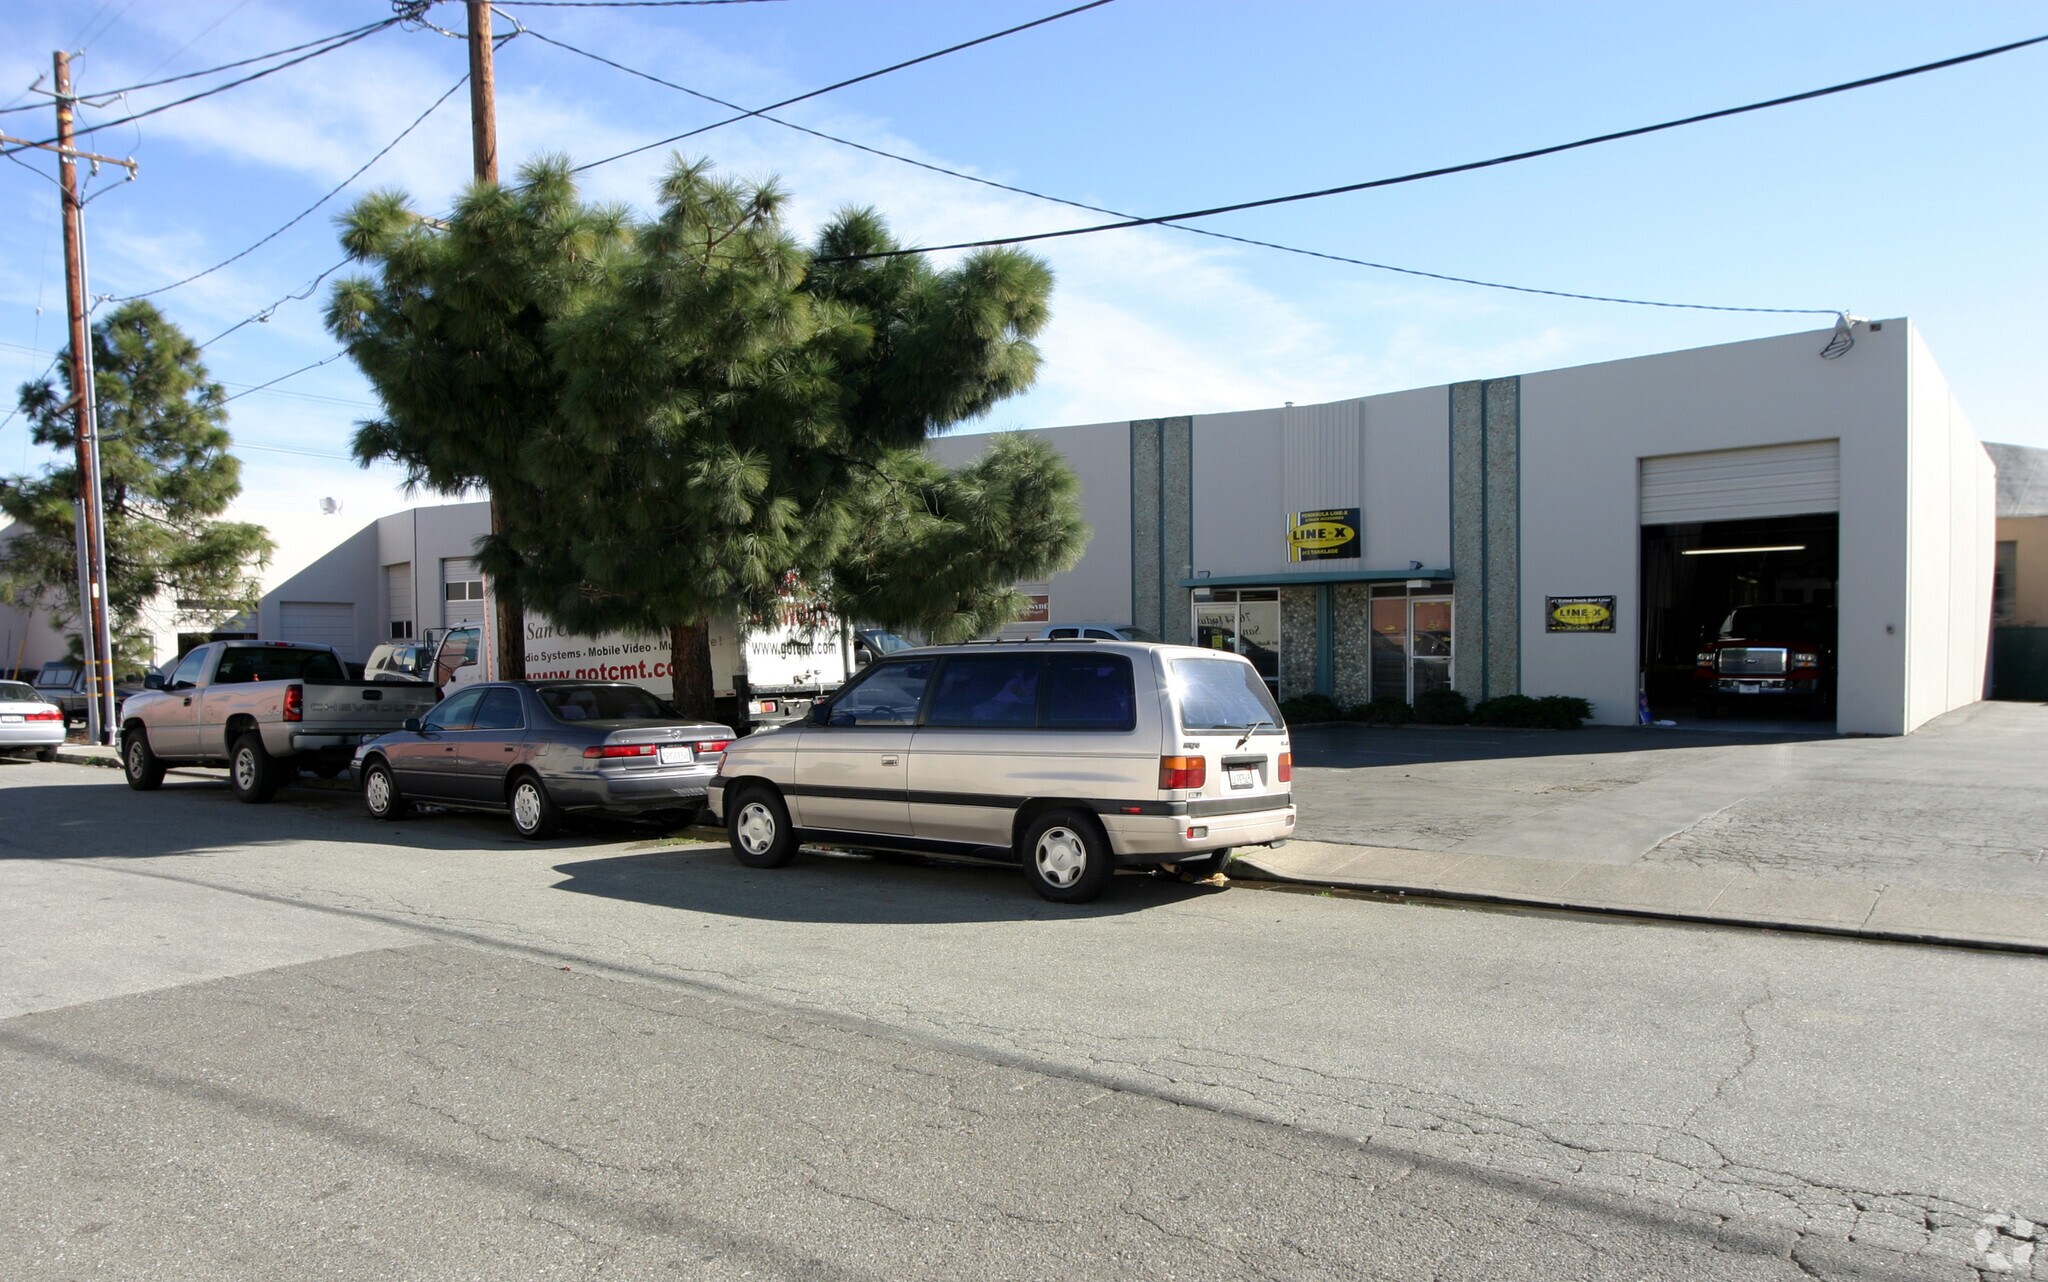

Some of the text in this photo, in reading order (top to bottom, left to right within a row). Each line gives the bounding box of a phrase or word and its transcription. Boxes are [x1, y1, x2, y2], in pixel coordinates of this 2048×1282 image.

[1292, 527, 1347, 541] LINE-X
[1559, 608, 1602, 617] LINE-X
[540, 649, 581, 663] Systems
[588, 643, 621, 657] Mobile
[622, 643, 651, 655] Video
